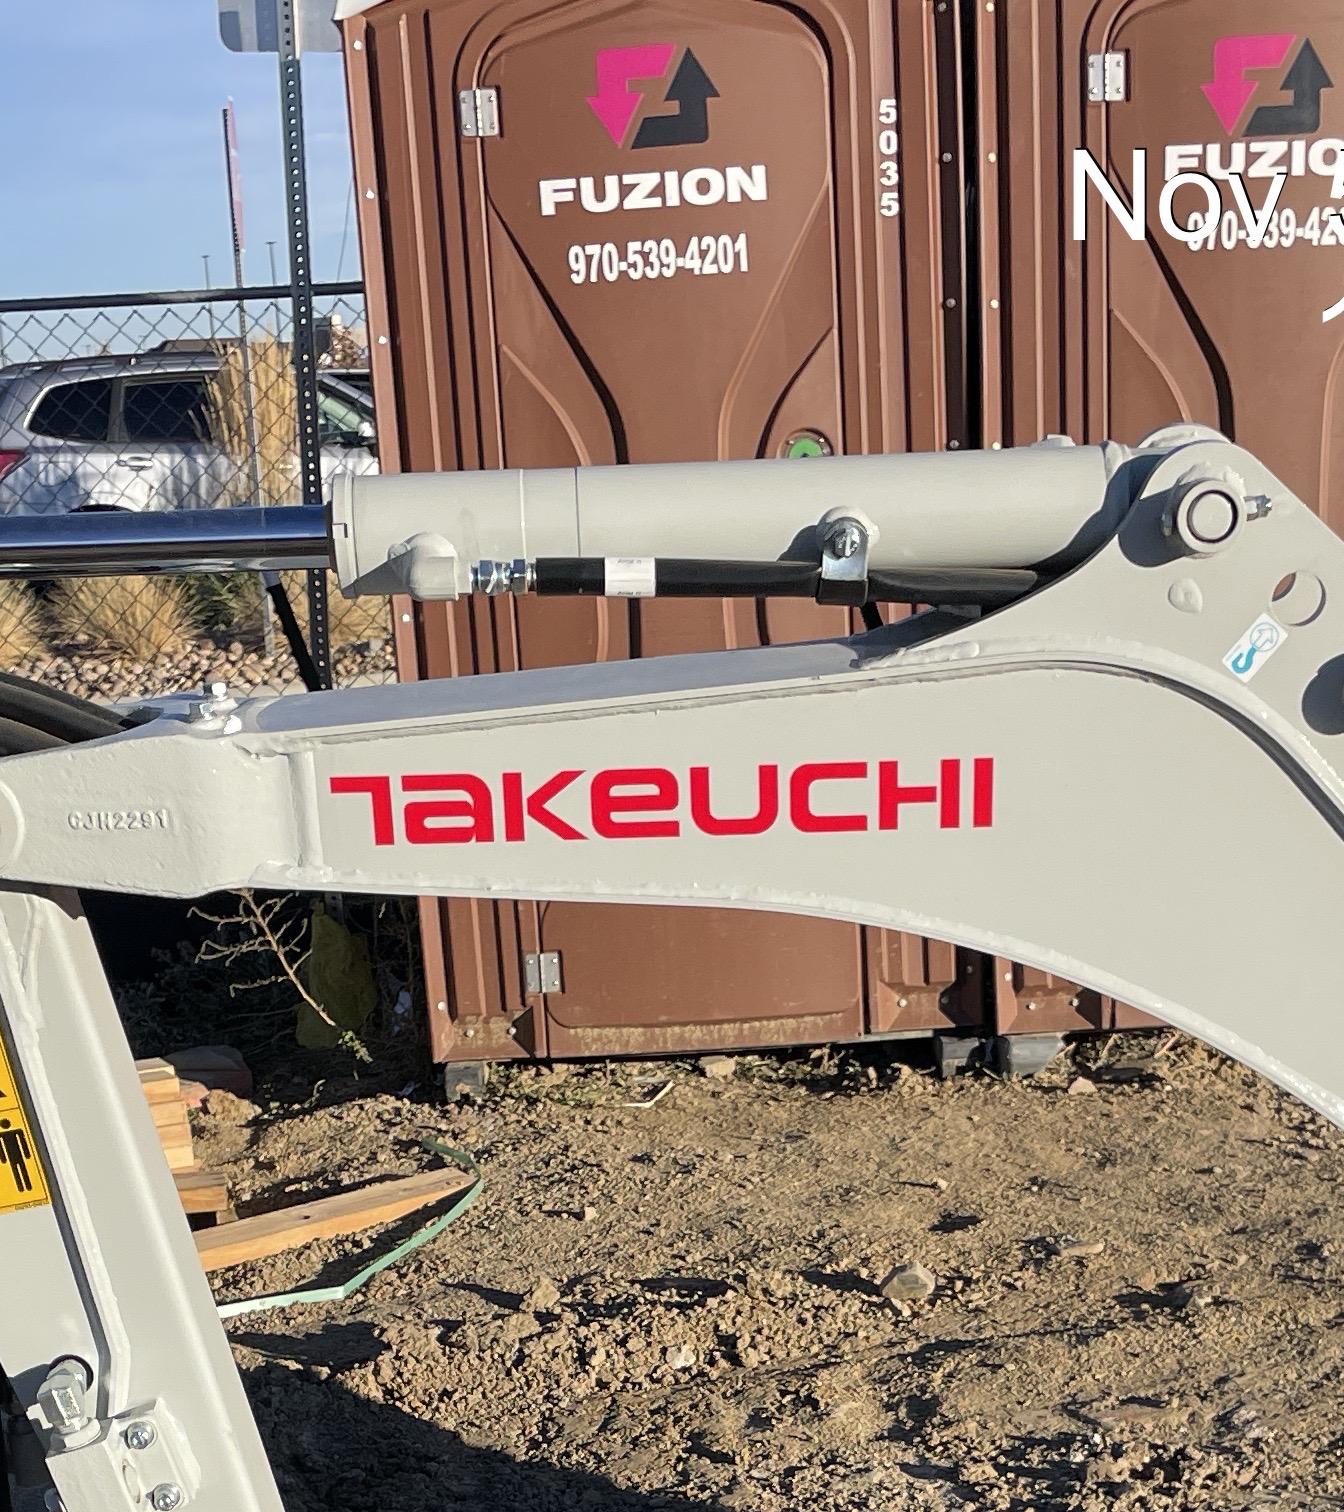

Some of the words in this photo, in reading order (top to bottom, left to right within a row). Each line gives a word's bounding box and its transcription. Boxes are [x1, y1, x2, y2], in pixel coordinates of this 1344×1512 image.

[877, 98, 900, 216] 5035
[538, 163, 768, 217] FUZION
[568, 232, 749, 284] 970-539-4201
